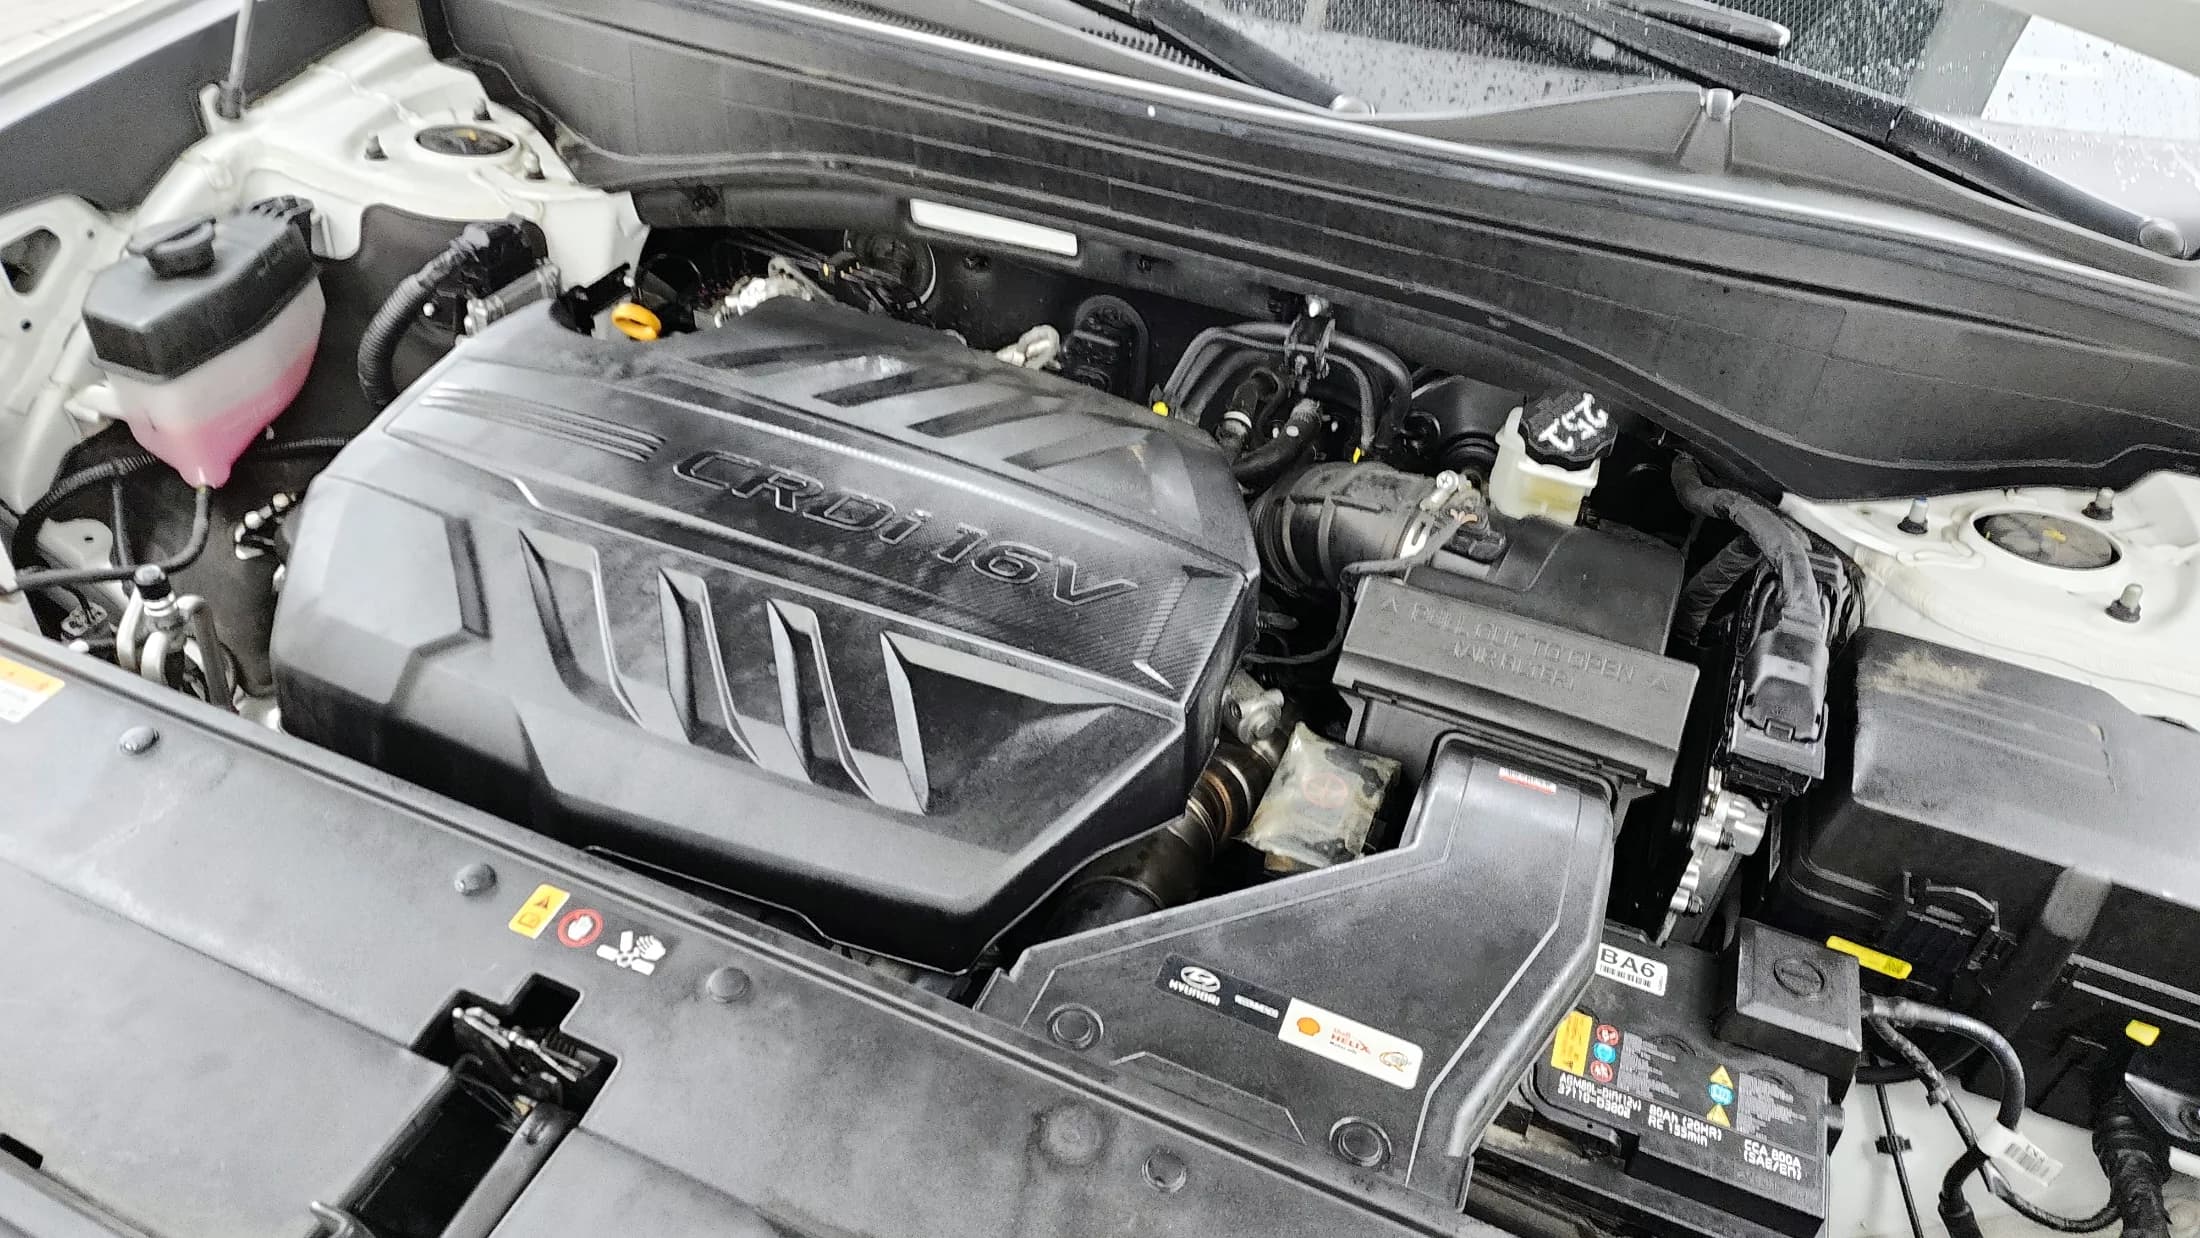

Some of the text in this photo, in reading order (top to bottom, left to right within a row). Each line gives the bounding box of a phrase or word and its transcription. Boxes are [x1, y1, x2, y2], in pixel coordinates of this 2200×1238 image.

[672, 450, 1139, 606] CRDi 16V
[1410, 602, 1470, 637] PULL
[1533, 638, 1564, 663] TO
[1567, 649, 1635, 682] OPEN
[1600, 948, 1656, 978] BA6
[1168, 978, 1221, 1007] HYUNDAI
[1331, 1033, 1371, 1055] HELIX
[1744, 1138, 1769, 1157] CCA
